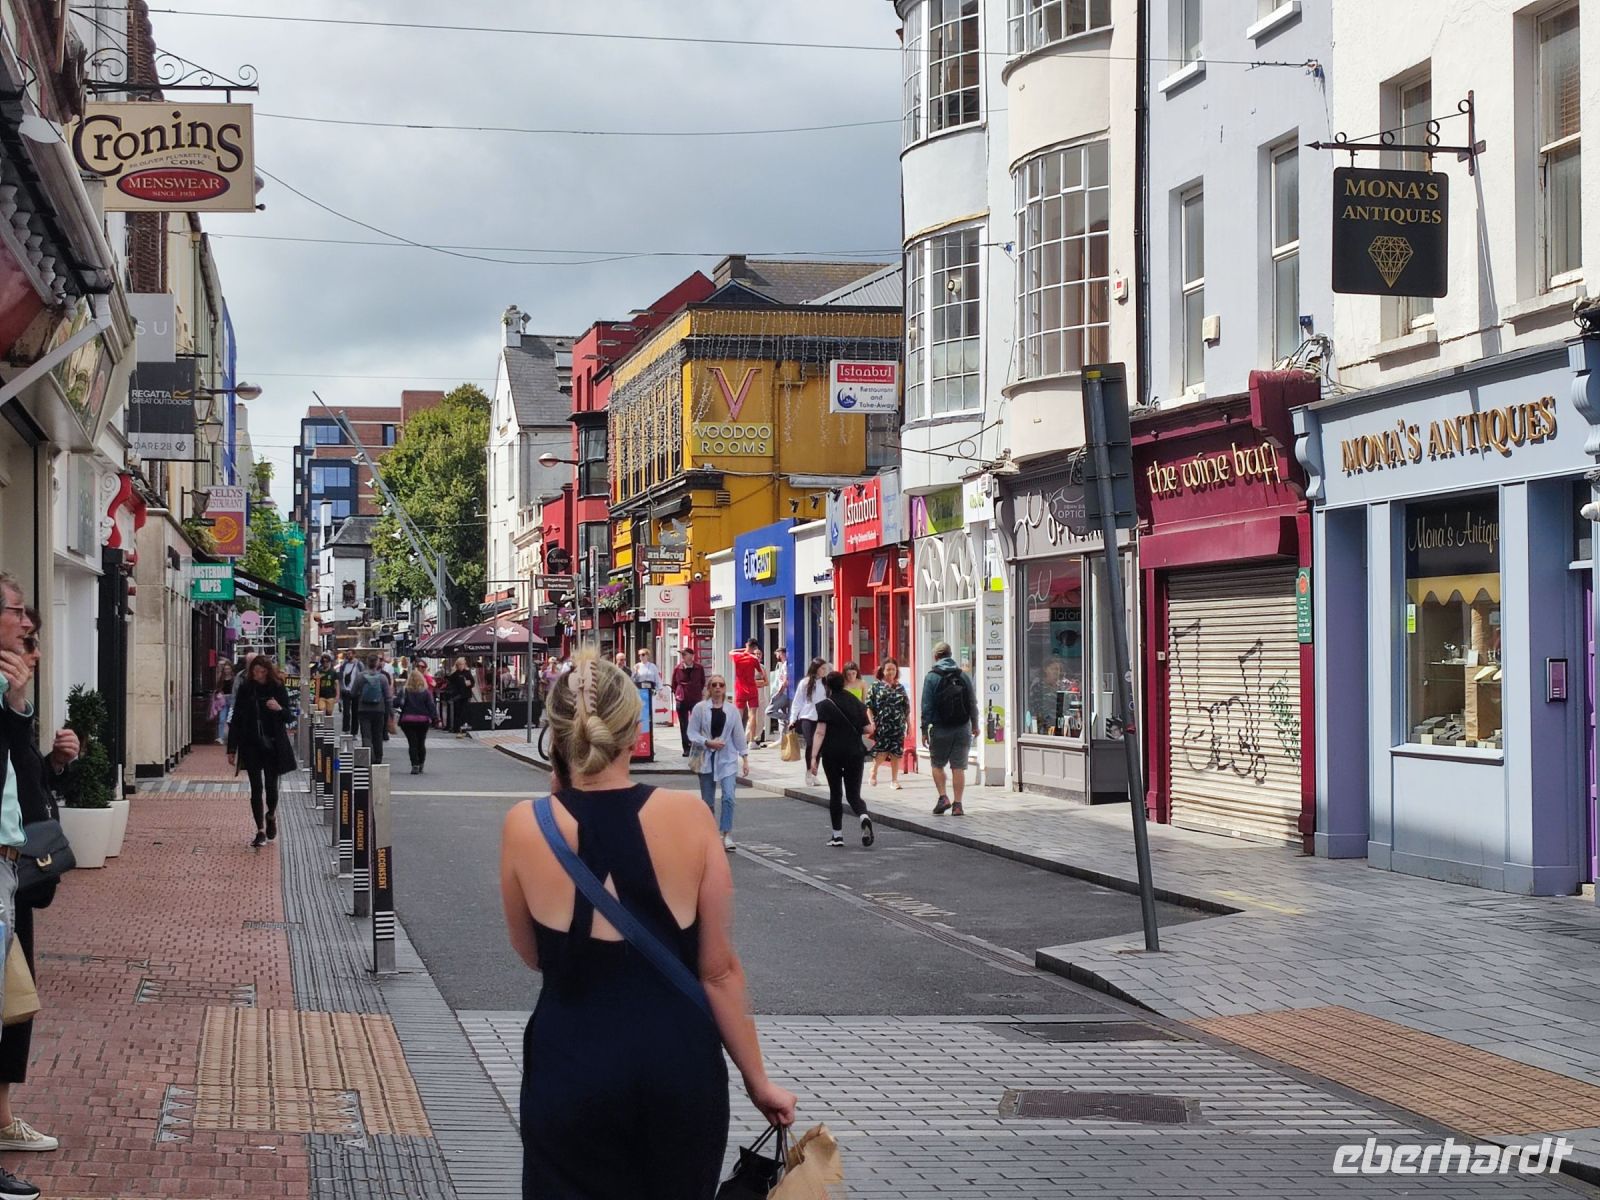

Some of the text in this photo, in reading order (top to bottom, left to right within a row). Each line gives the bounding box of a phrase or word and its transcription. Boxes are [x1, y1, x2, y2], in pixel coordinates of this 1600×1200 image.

[72, 110, 244, 177] Cronins
[128, 177, 220, 189] MENSWEAR
[1344, 178, 1439, 201] MONA'S
[1341, 204, 1442, 225] ANTIQUES
[840, 364, 892, 377] Istanbul
[131, 389, 172, 399] REGATTA
[153, 398, 193, 406] OUTDOORS
[859, 402, 895, 410] Take-Away
[697, 425, 771, 439] VOODOO
[1341, 396, 1557, 474] MONA'S ANTIQUES
[701, 441, 767, 453] ROOMS
[1146, 442, 1281, 493] the wine buff
[844, 486, 878, 526] Istanbul
[1408, 512, 1454, 551] Mona's
